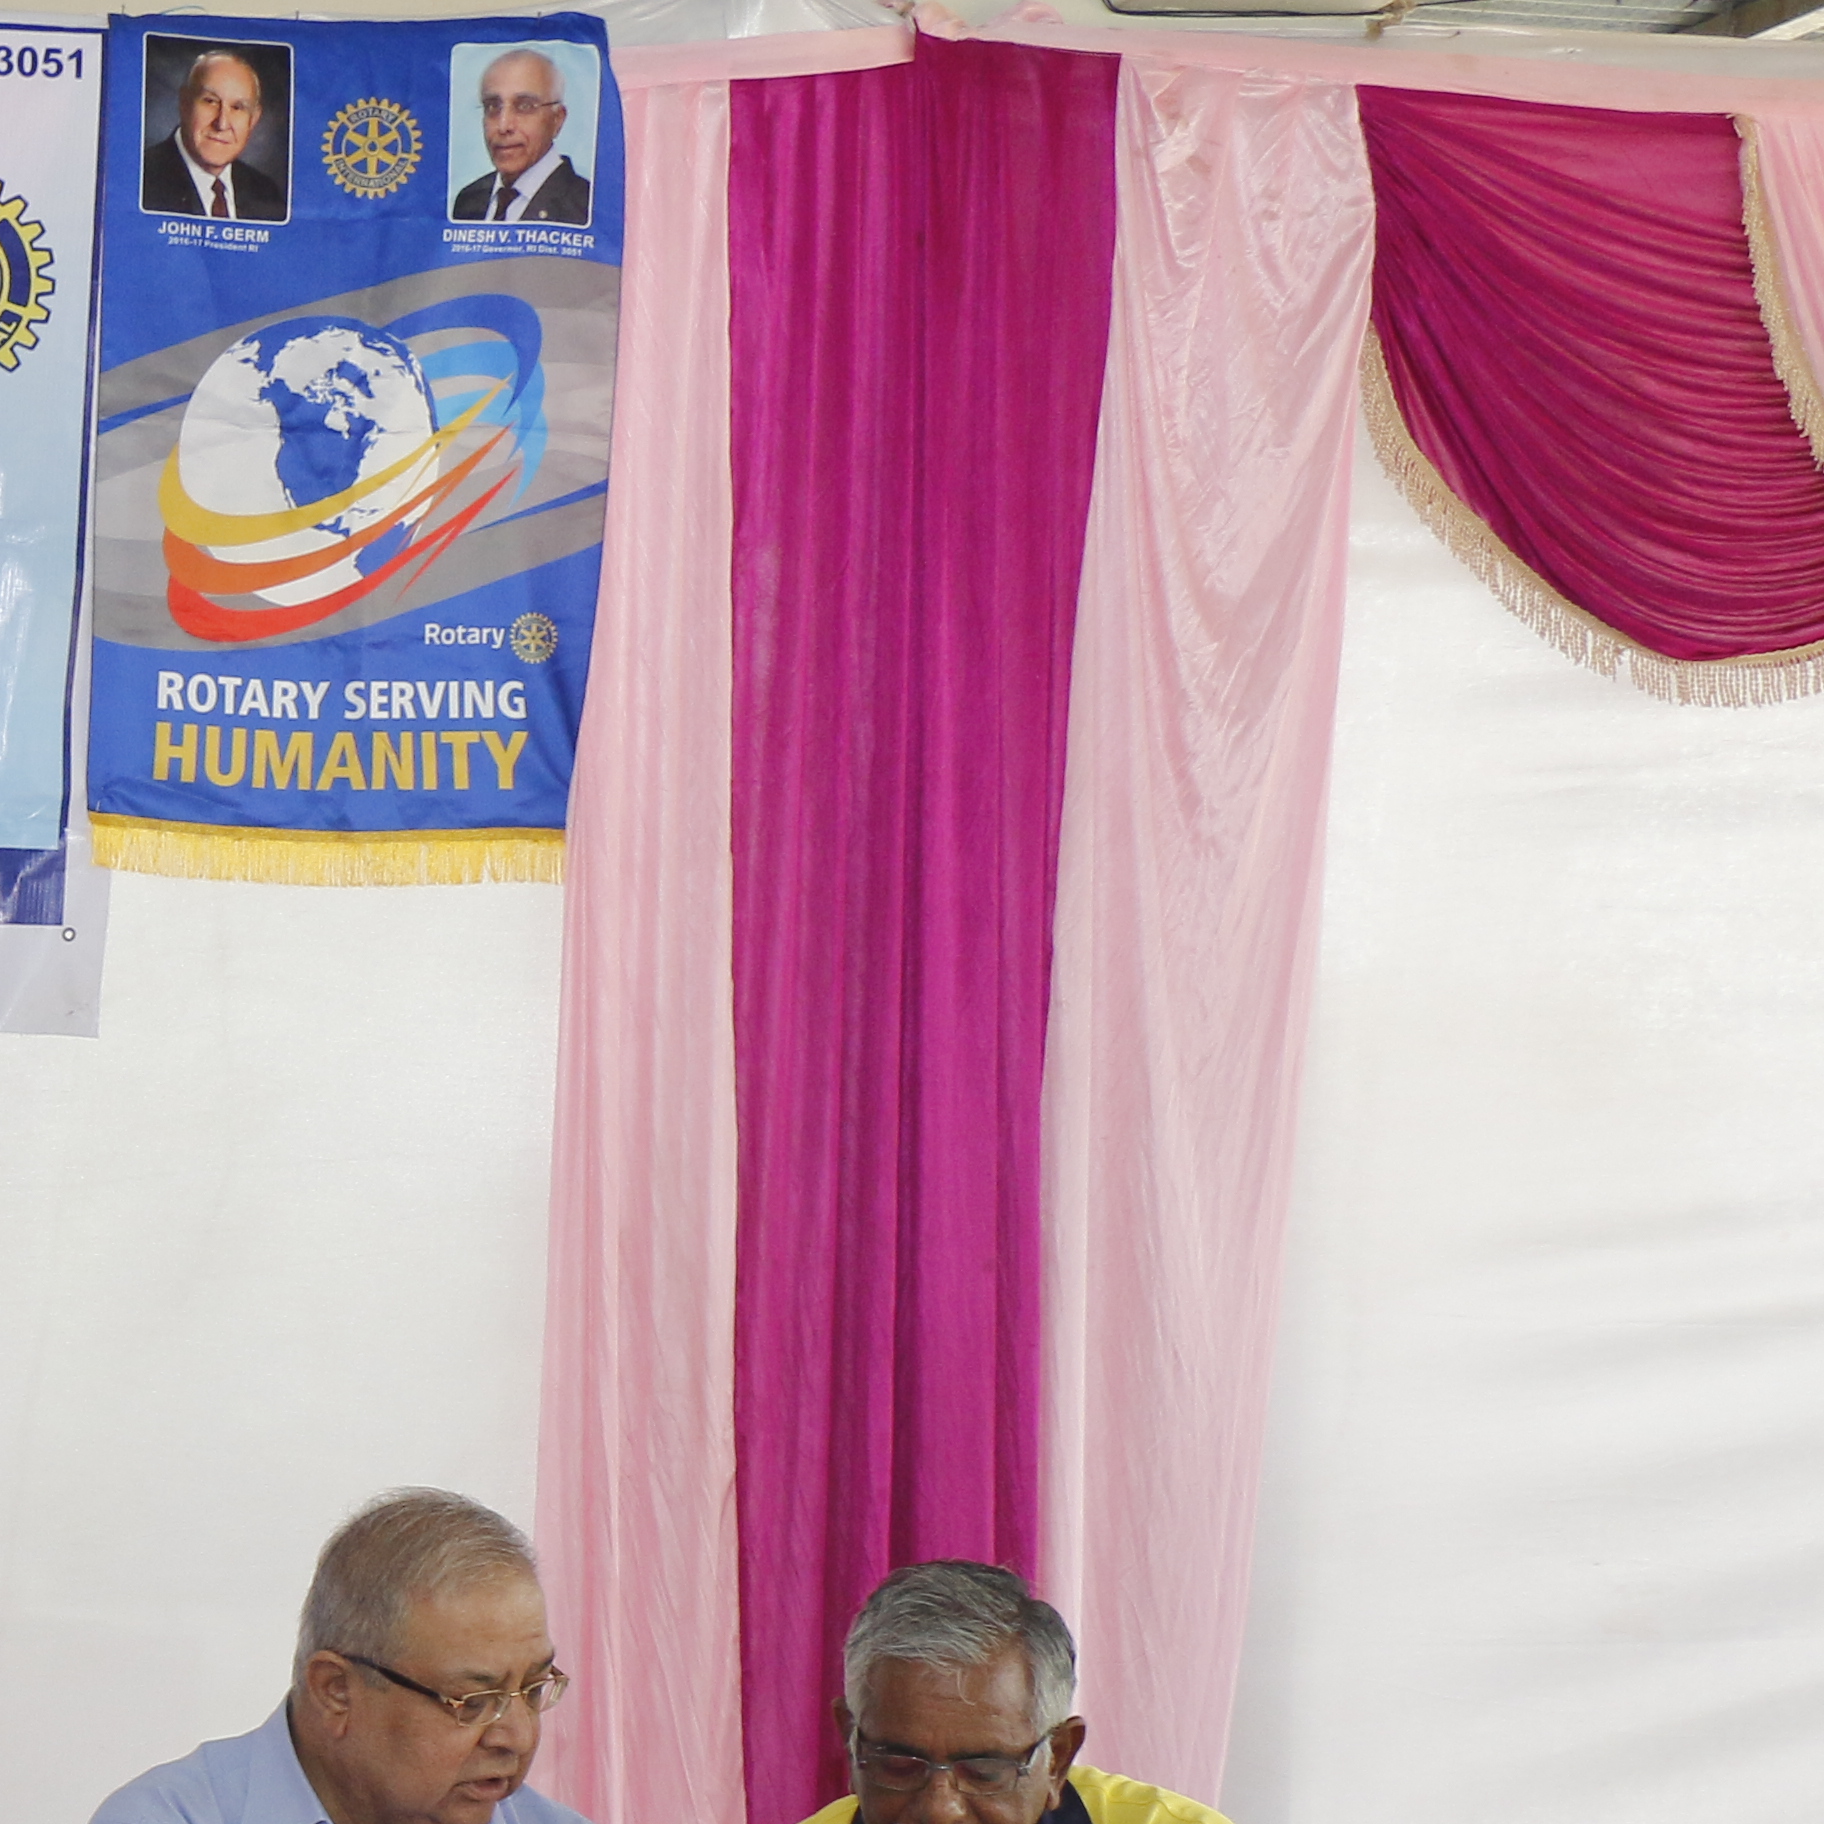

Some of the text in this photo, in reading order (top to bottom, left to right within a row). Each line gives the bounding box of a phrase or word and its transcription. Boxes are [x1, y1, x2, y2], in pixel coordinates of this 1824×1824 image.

[348, 107, 396, 122] ROTARY
[335, 159, 409, 188] INTERNATIONAL
[157, 221, 270, 243] JOHN F. GERM
[442, 228, 595, 248] DINESH V. THACKER
[424, 622, 505, 649] Rotary
[156, 670, 528, 720] ROTARY SERVING
[152, 721, 529, 791] HUMANITY
